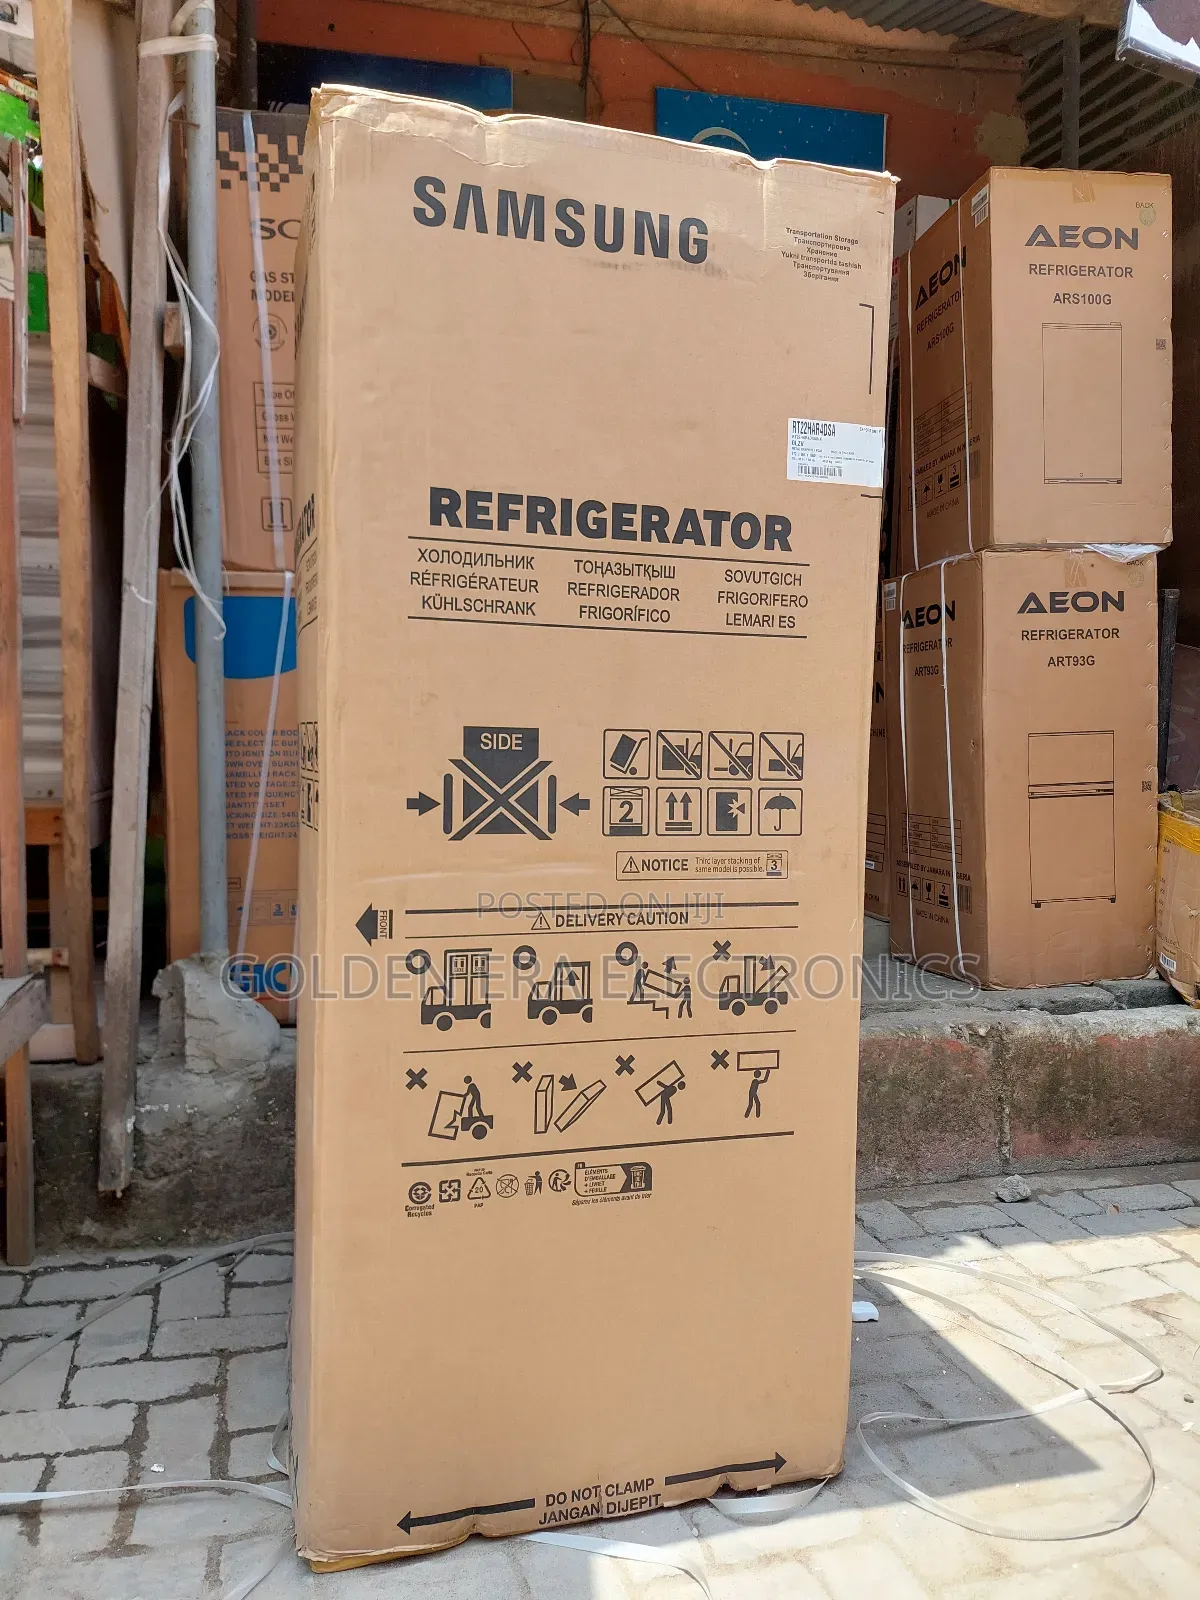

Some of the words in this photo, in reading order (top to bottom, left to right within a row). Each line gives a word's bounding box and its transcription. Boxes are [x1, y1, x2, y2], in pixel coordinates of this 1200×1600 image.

[412, 175, 709, 264] SAMSUNG
[785, 227, 832, 241] Transportation
[834, 235, 858, 245] Storage
[1024, 224, 1138, 251] AEON
[915, 245, 966, 312] AEON
[1028, 264, 1134, 279] REFRIGERATOR
[1053, 292, 1112, 305] ARS100G
[792, 420, 836, 437] RT22HAR4DSA
[429, 486, 792, 552] REFRIGERATOR
[417, 548, 535, 570] ХОЛОДИЛЬНИК
[573, 559, 676, 581] ТОҢАЗЫТҚЫШ
[724, 569, 802, 586] SOVUTGICH
[410, 569, 539, 593] RÉFRIGÉRATEUR
[567, 581, 680, 601] REFRIGERADOR
[717, 591, 808, 608] FRIGORIFERO
[422, 593, 536, 616] KÜHLSCHRANK
[1016, 591, 1125, 614] AEON
[579, 605, 671, 622] FRIGORÍFICO
[725, 612, 774, 628] LEMARI
[779, 616, 796, 628] ES
[902, 600, 956, 629] AEON
[1021, 628, 1120, 641] REFRIGERATOR
[1047, 655, 1095, 667] ART93G
[914, 665, 939, 676] ART93G
[480, 732, 523, 751] SIDE
[618, 800, 634, 822] 2
[641, 858, 689, 872] NOTICE
[753, 856, 761, 865] of
[770, 860, 778, 871] 3
[379, 910, 388, 939] FRONT
[555, 912, 625, 927] DELIVERY
[627, 911, 689, 925] CAUTION
[474, 1186, 484, 1194] 20
[546, 1491, 568, 1507] DO
[571, 1485, 602, 1503] NOT
[604, 1478, 655, 1497] CLAMP
[539, 1501, 601, 1525] JANGAN
[606, 1493, 662, 1514] DIJEPIT
